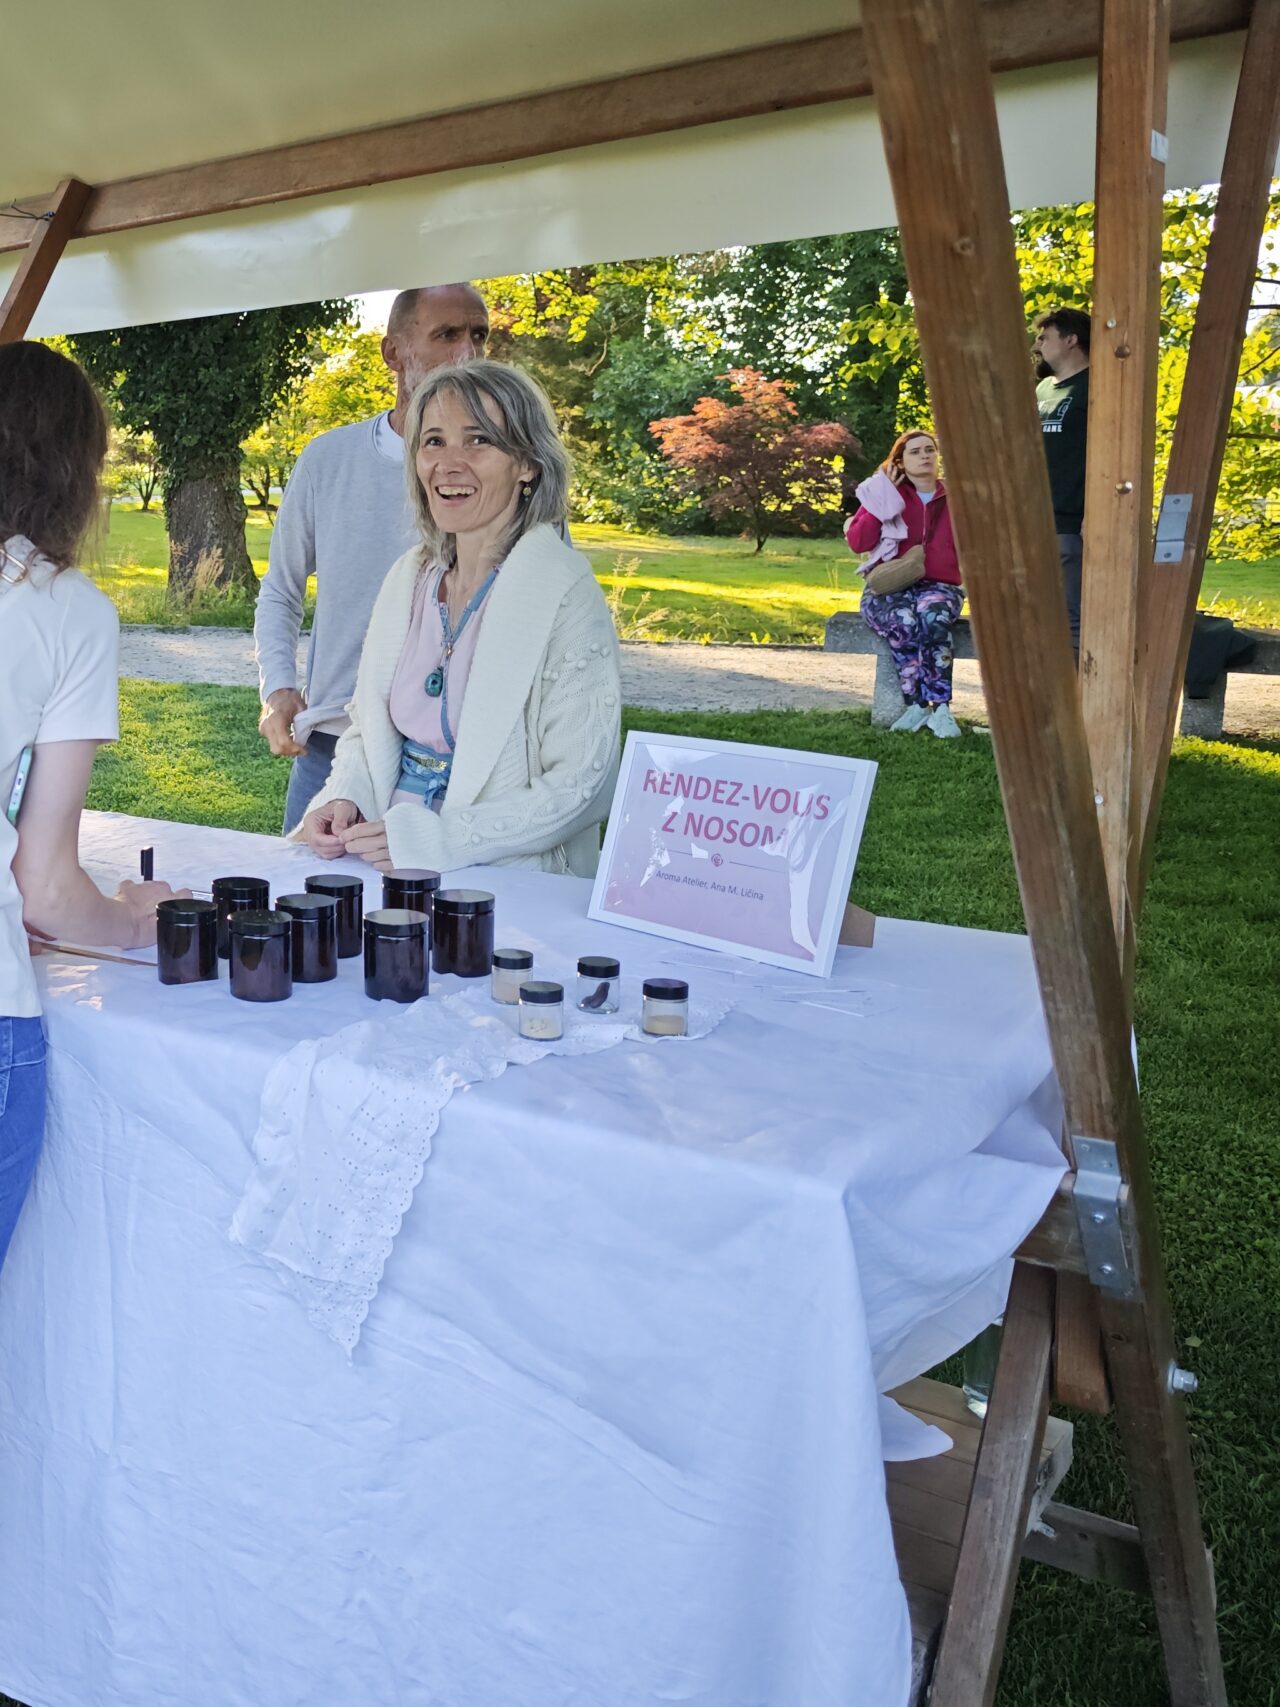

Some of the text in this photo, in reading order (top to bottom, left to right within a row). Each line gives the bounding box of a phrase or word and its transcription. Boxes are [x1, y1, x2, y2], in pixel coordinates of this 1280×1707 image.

[643, 769, 831, 820] RENDEZ-VOUS
[661, 810, 679, 833] Z
[655, 870, 765, 901] Aroma Atelier, Ana M. Ličina
